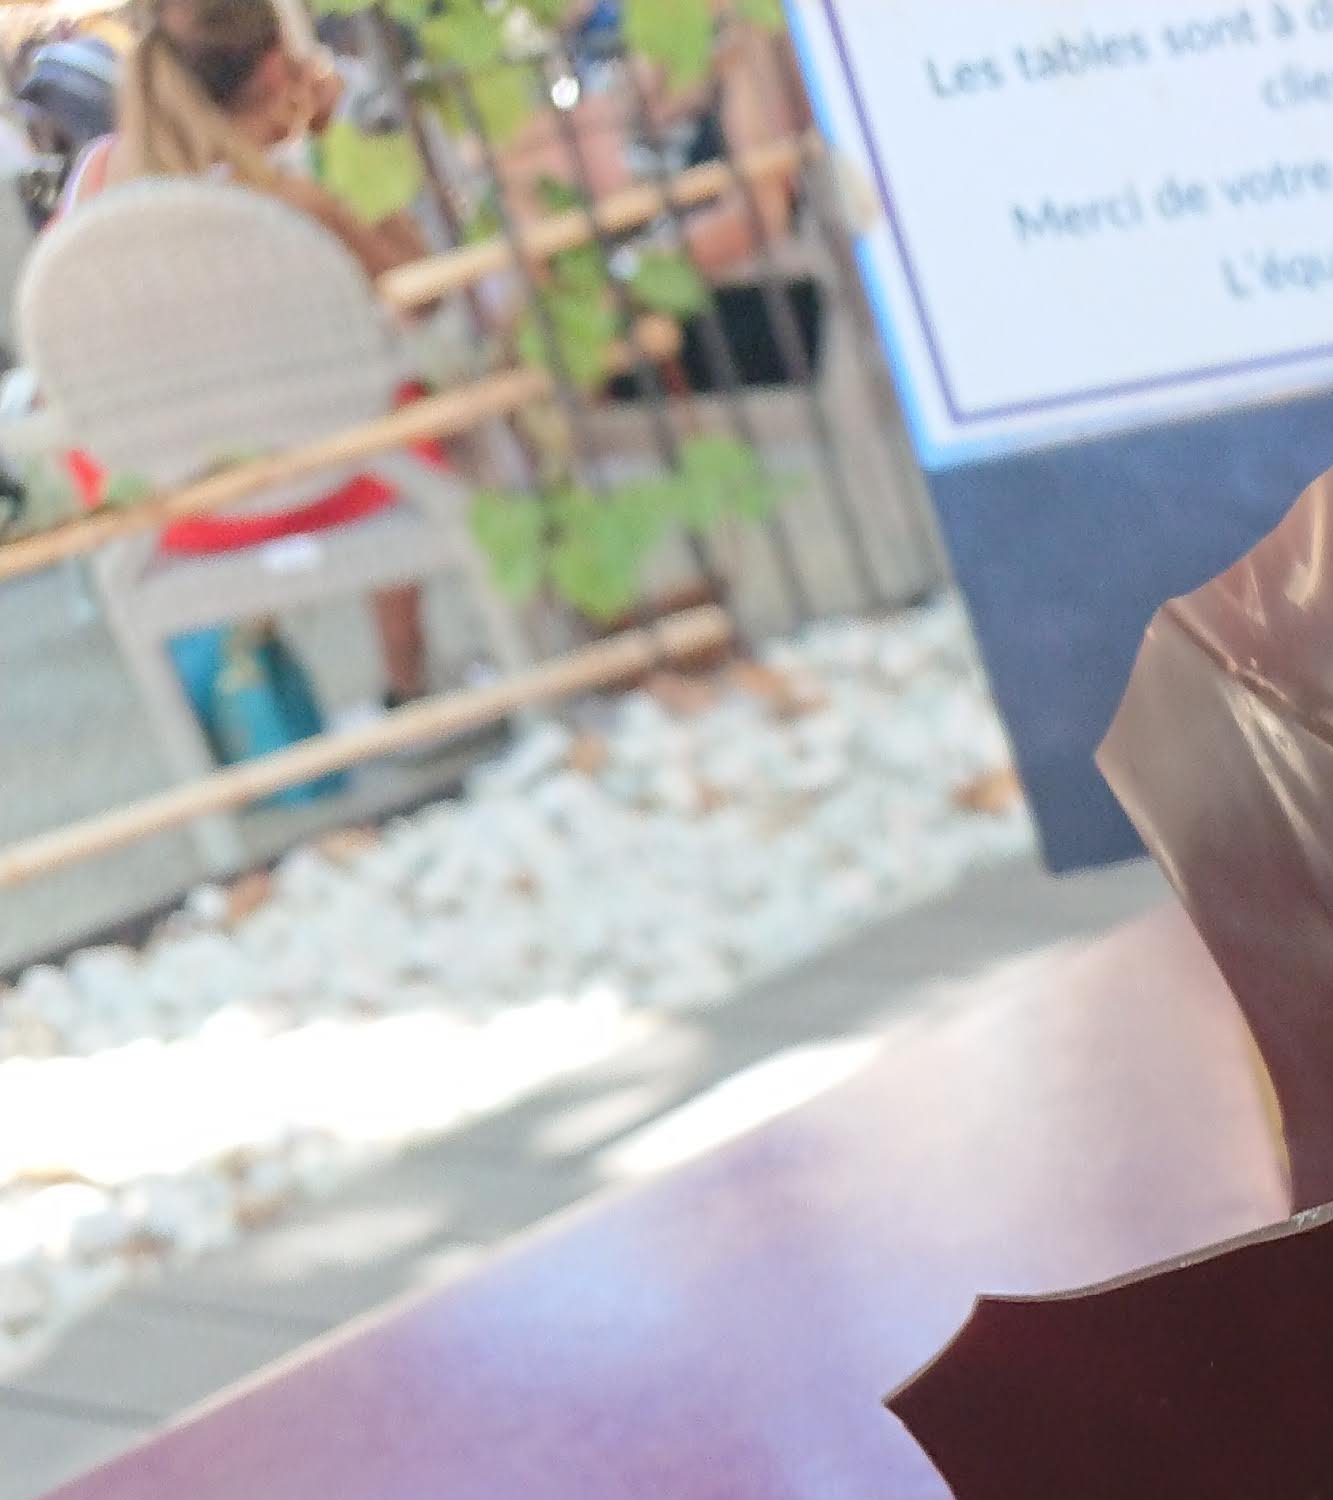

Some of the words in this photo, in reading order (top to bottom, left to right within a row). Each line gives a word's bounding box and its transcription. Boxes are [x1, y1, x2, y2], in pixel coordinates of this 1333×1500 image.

[926, 57, 1005, 99] Les
[1014, 26, 1149, 82] tables
[1163, 10, 1258, 55] sont
[1012, 178, 1144, 241] Merci
[1153, 170, 1209, 219] de
[1220, 157, 1333, 205] votre
